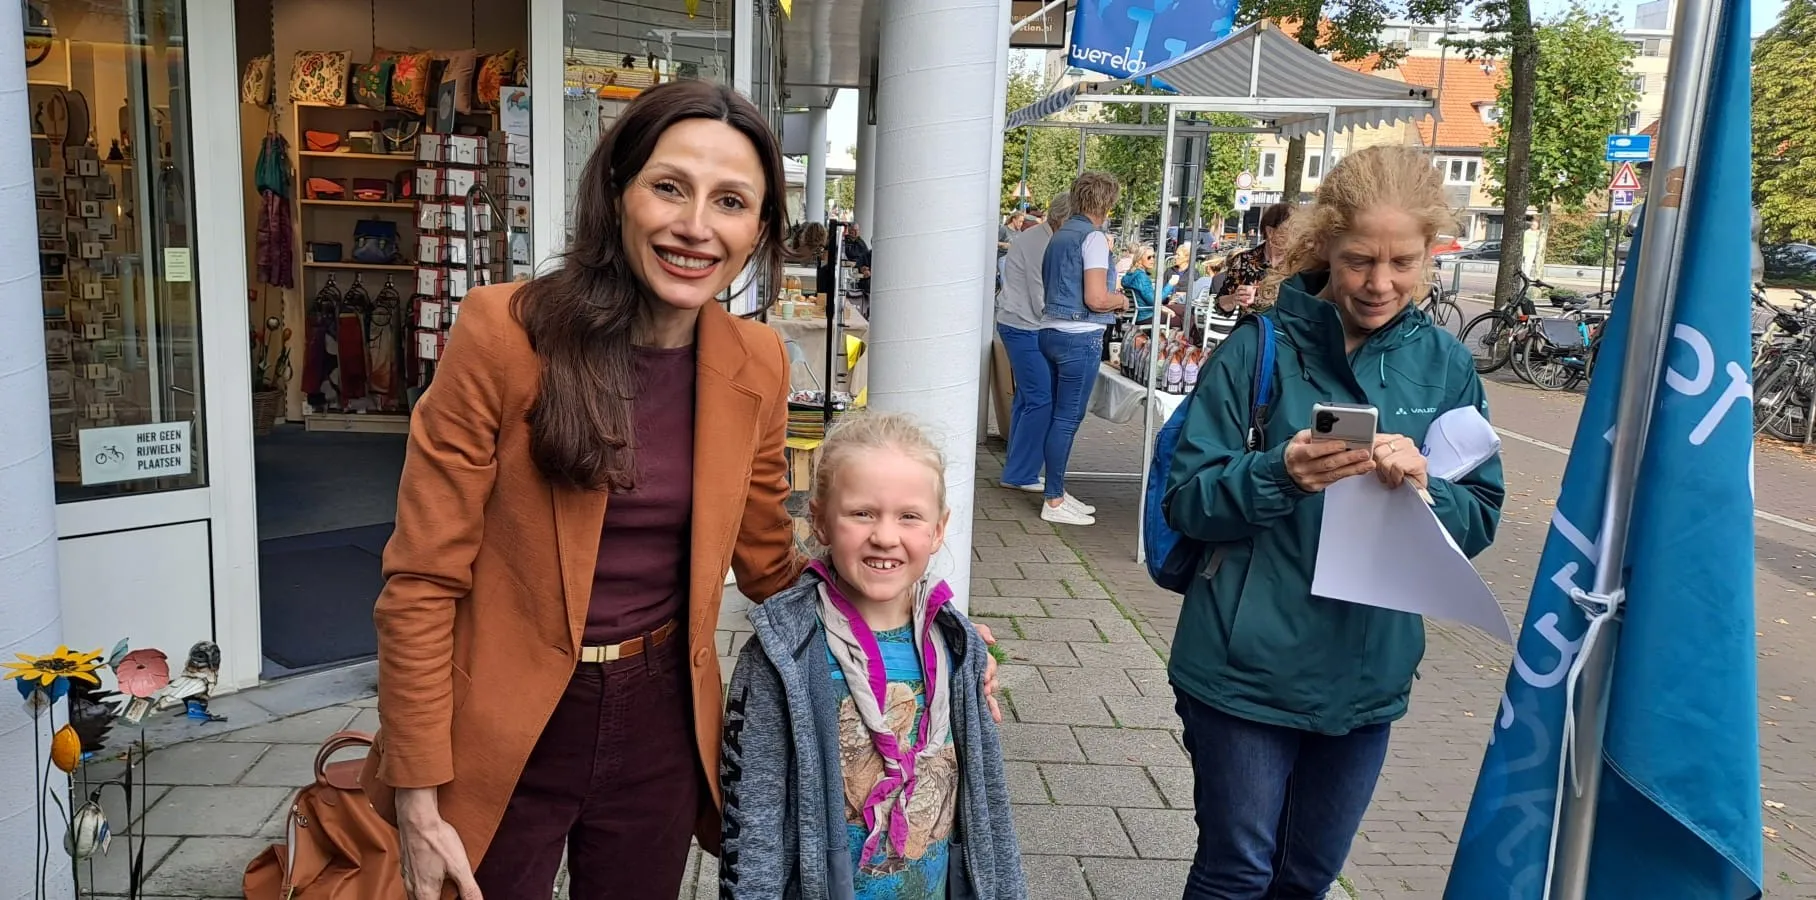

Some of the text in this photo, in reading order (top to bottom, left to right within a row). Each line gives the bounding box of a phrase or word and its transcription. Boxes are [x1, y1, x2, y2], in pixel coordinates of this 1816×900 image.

[1071, 44, 1146, 73] wereld
[137, 430, 181, 443] HIER GEEN
[137, 443, 181, 457] RIJWIELEN
[138, 457, 181, 470] PLAATSEN
